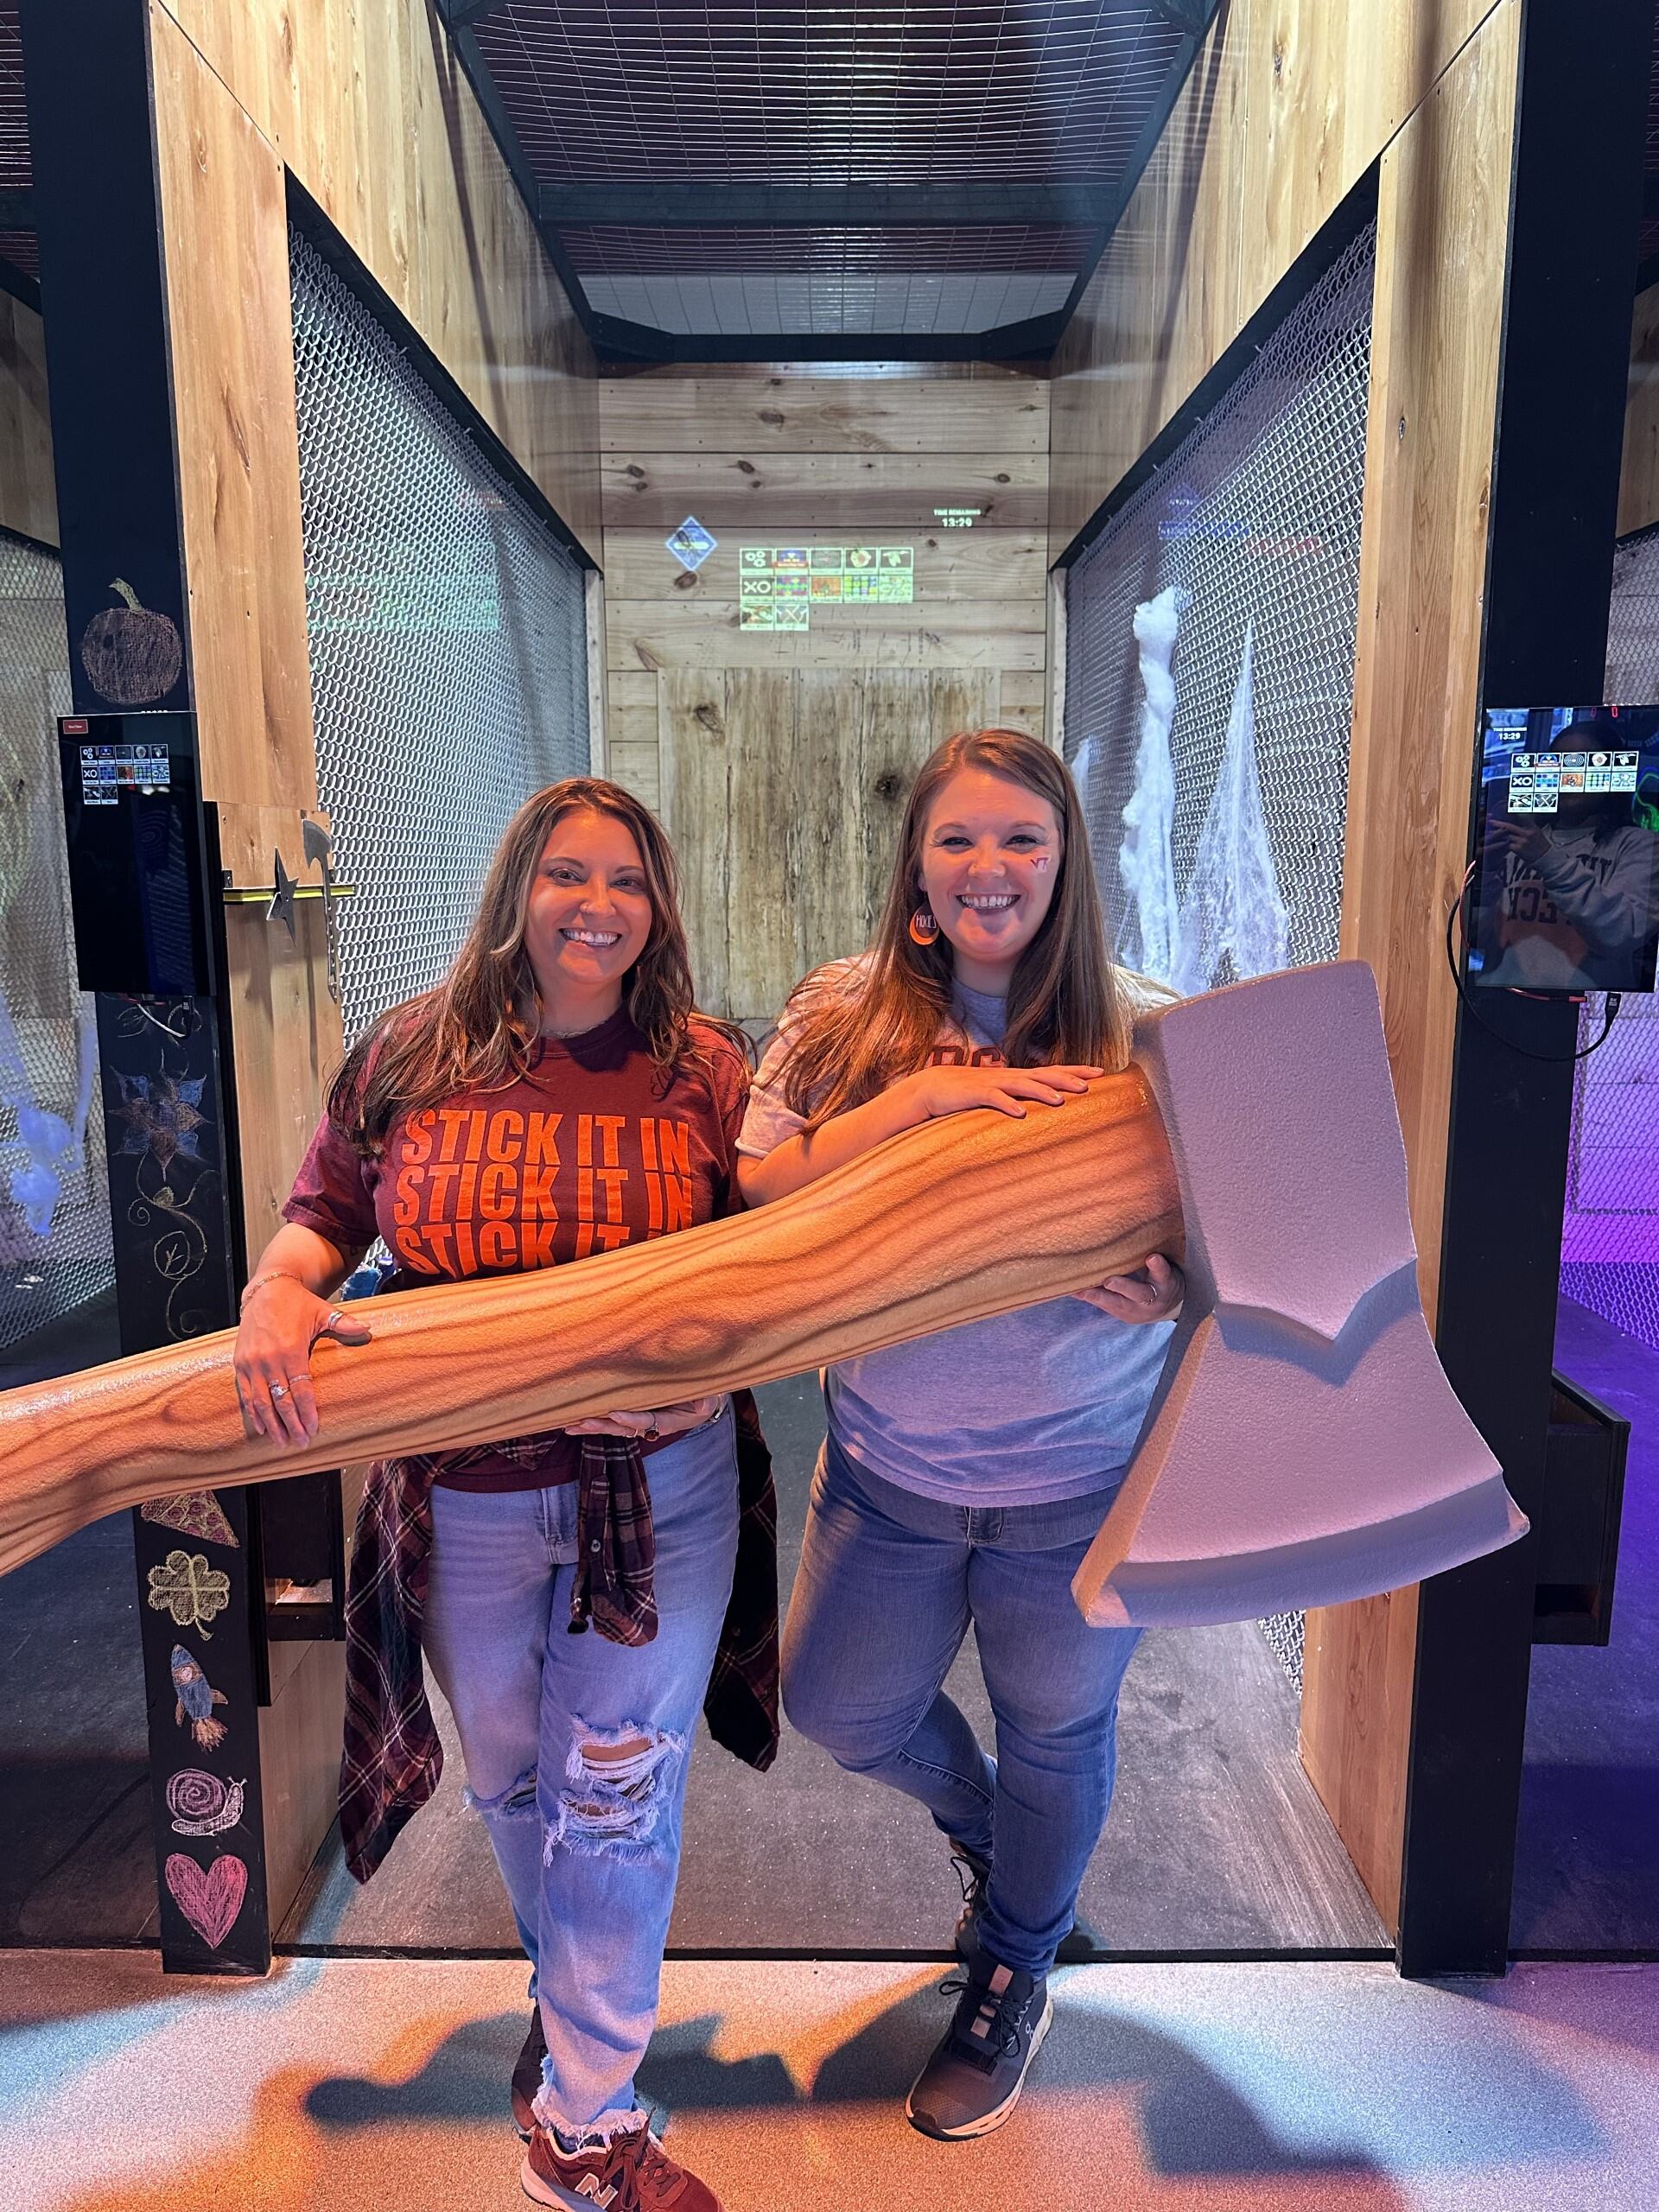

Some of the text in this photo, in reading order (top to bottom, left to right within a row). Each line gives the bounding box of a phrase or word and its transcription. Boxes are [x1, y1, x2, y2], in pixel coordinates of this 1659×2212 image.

[1498, 732, 1521, 741] 13:29
[401, 1109, 690, 1175] STICK IT IN
[393, 1163, 693, 1237] STICK IT IN
[395, 1220, 559, 1280] STICK
